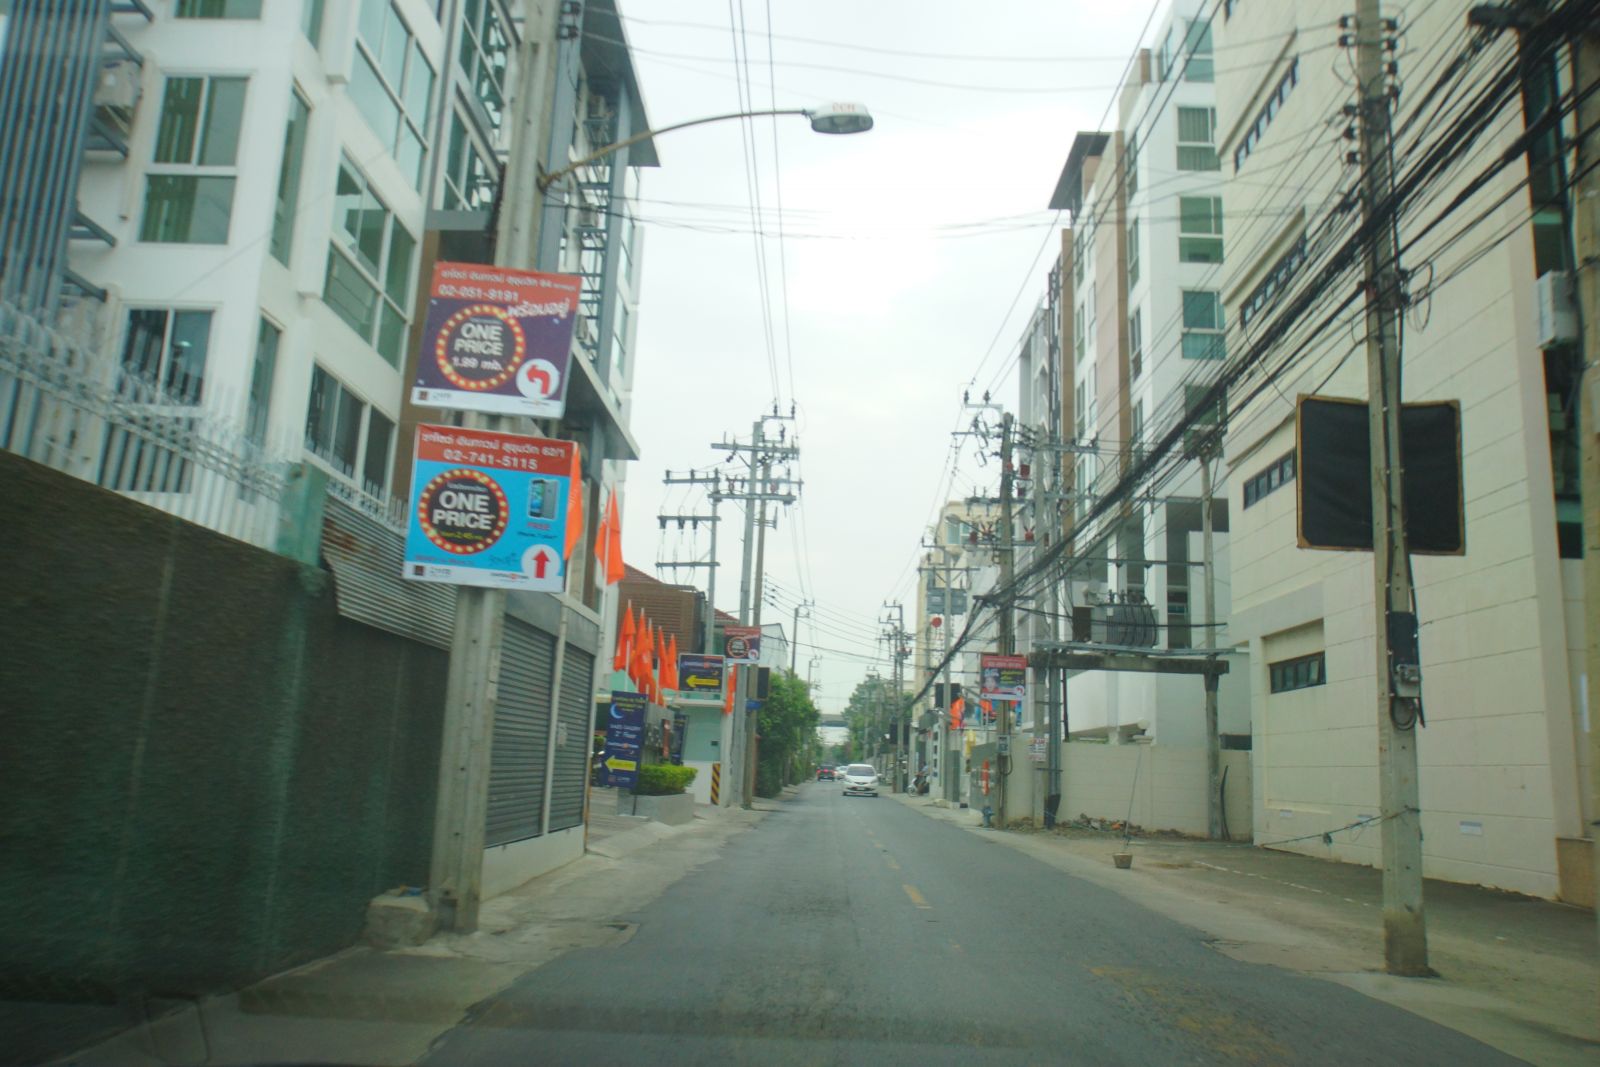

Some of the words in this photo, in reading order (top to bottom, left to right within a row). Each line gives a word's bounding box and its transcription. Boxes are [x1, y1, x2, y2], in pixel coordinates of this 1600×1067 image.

[460, 323, 503, 341] ONE
[454, 338, 503, 356] PRICE
[443, 449, 538, 470] 02-741-5115
[438, 490, 490, 512] ONE
[432, 509, 492, 530] PRICE
